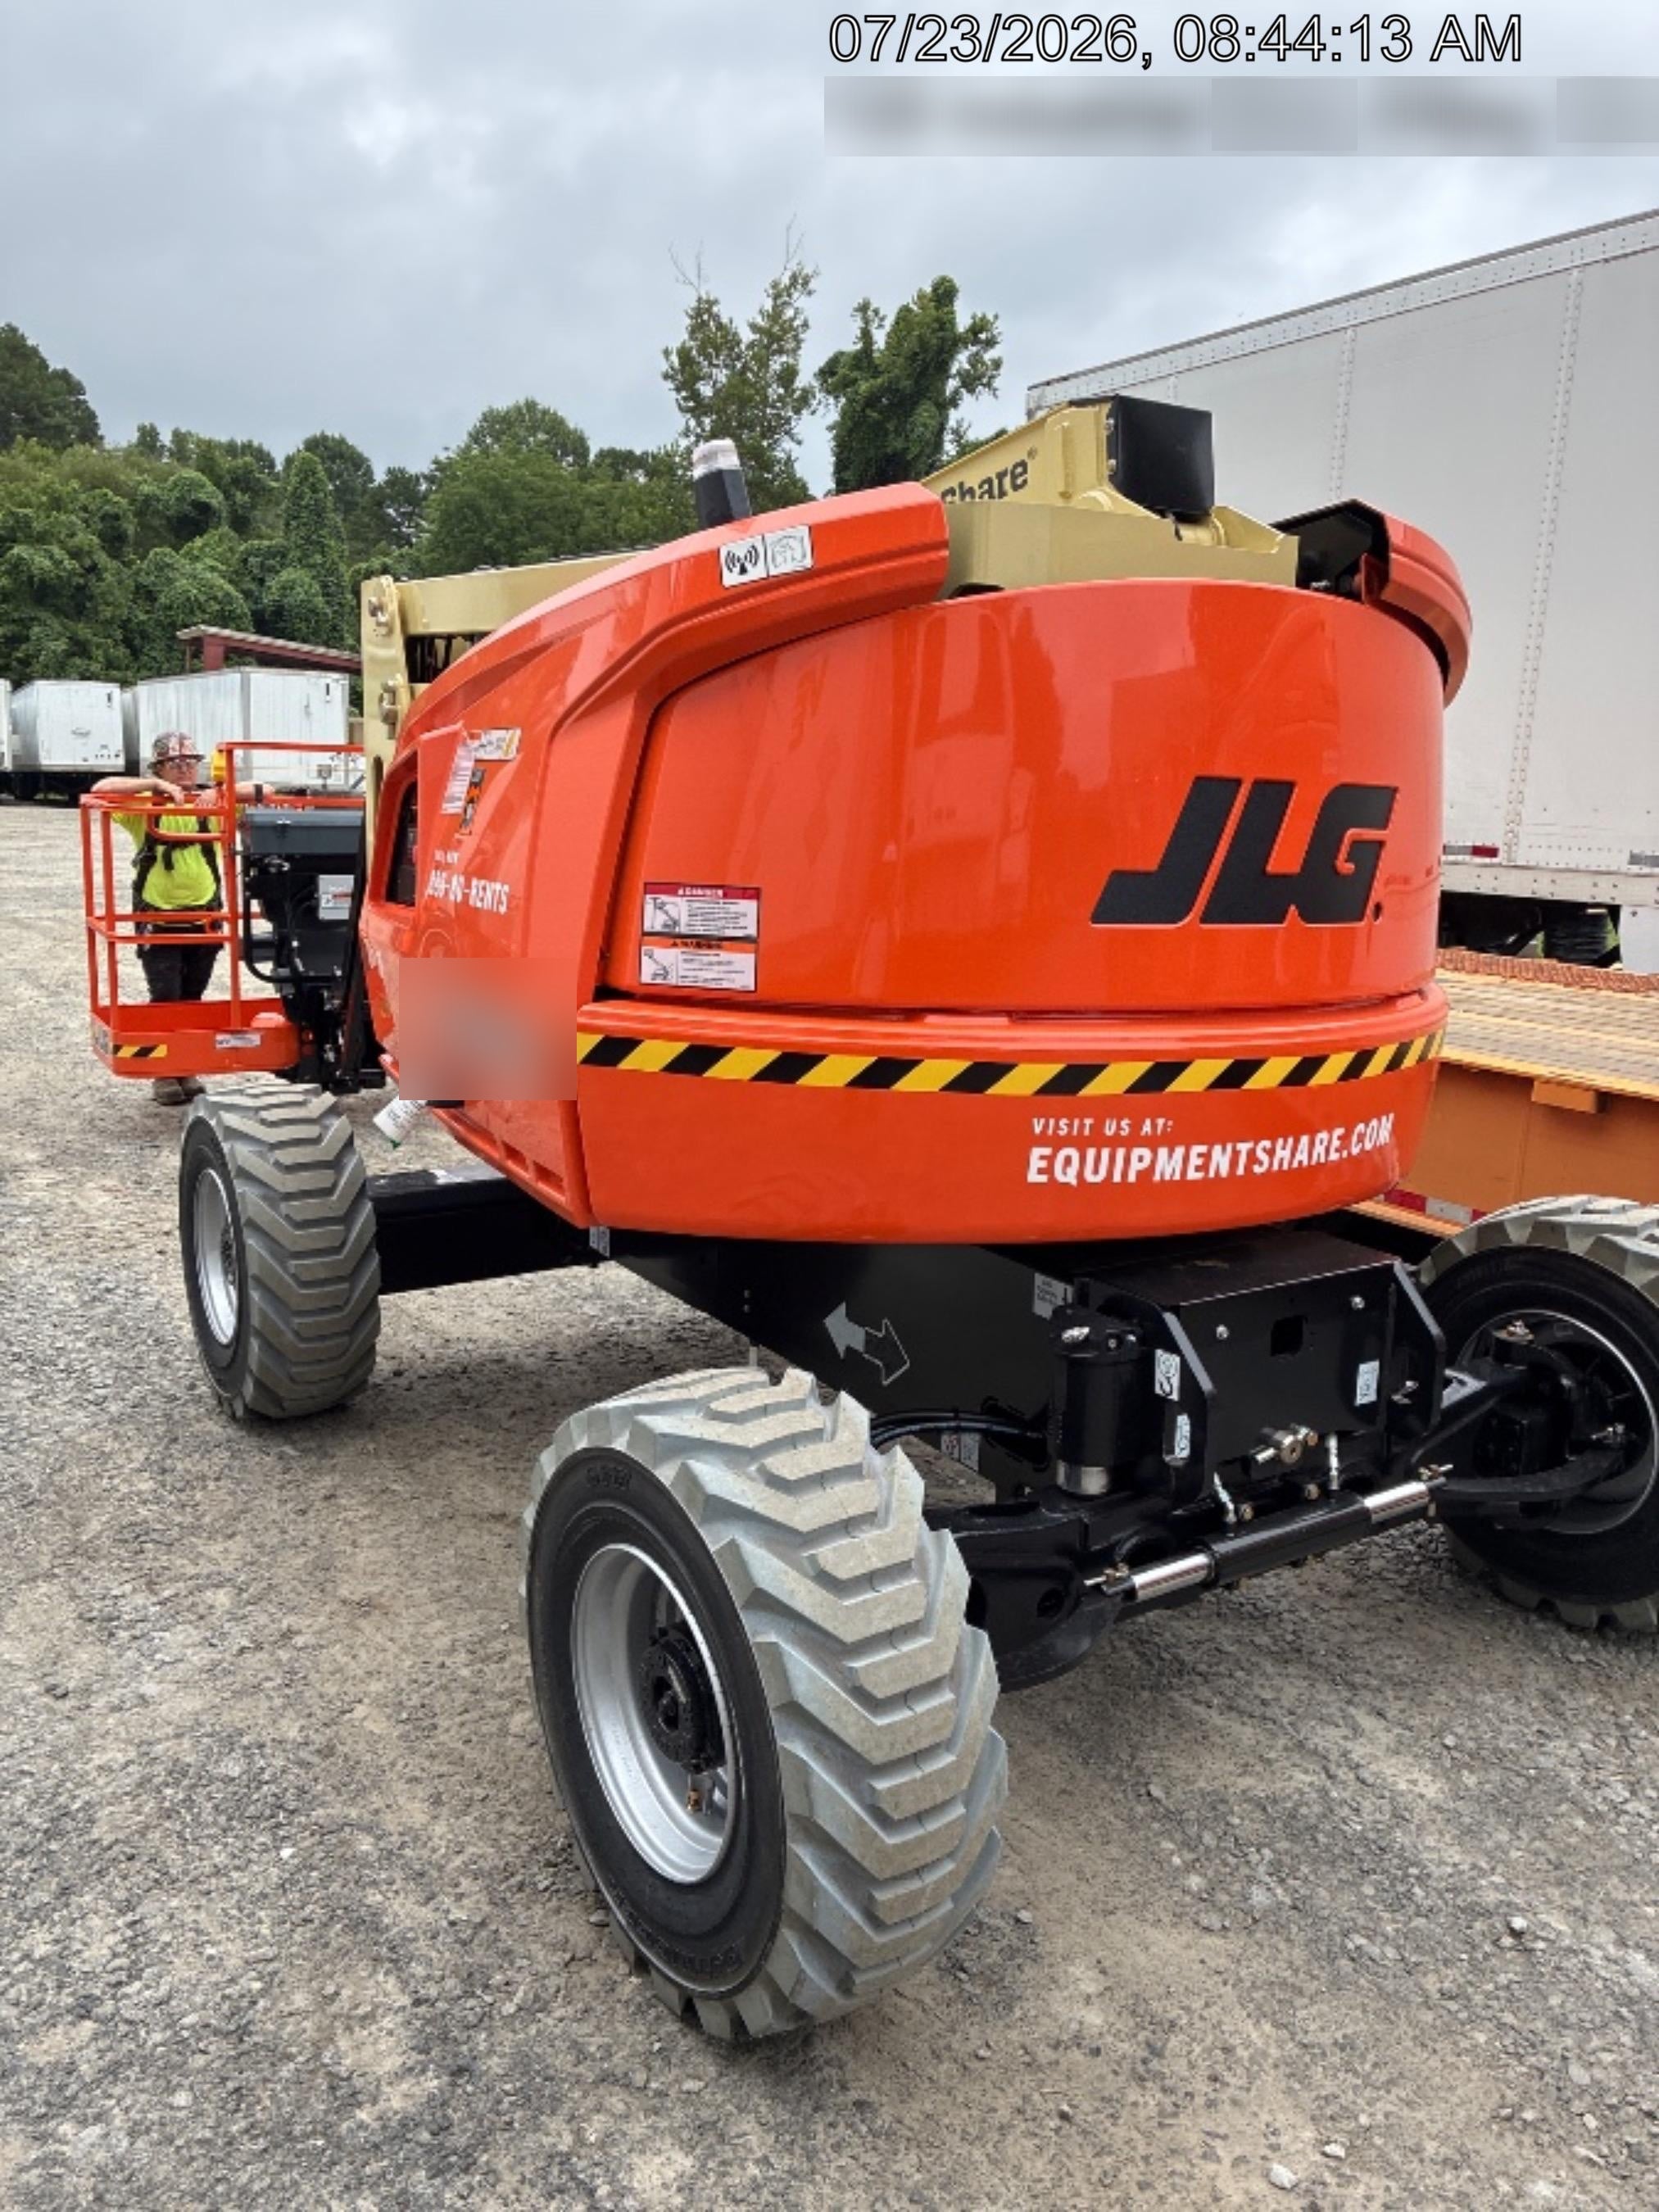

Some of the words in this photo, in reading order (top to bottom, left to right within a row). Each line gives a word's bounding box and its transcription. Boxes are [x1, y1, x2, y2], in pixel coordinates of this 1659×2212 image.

[1027, 1113, 1395, 1186] EQUIPMENTSHARE.COM
[1031, 1117, 1095, 1136] VISIT
[1104, 1117, 1132, 1136] US
[1140, 1117, 1174, 1135] AT:
